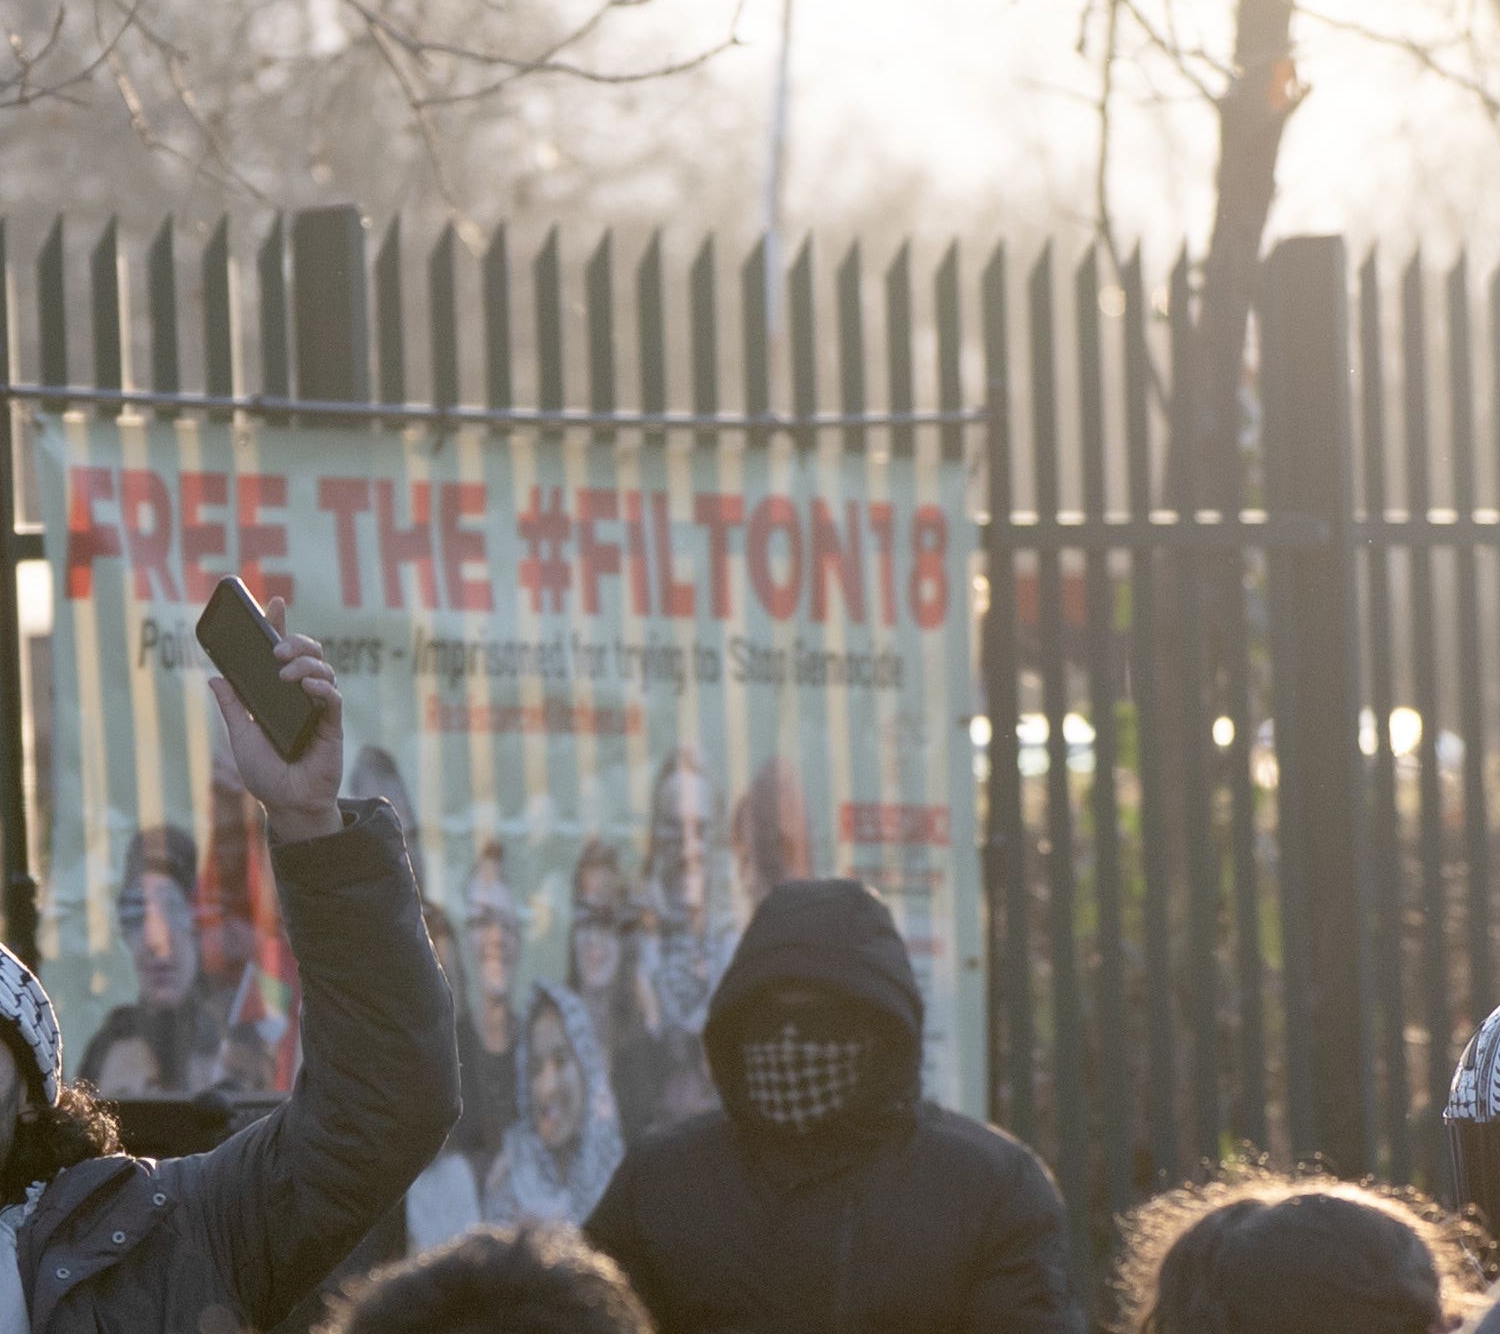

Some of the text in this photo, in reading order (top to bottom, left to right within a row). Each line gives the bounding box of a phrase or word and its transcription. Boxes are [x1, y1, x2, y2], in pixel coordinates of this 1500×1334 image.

[64, 467, 950, 631] FREE THE #FILTON18
